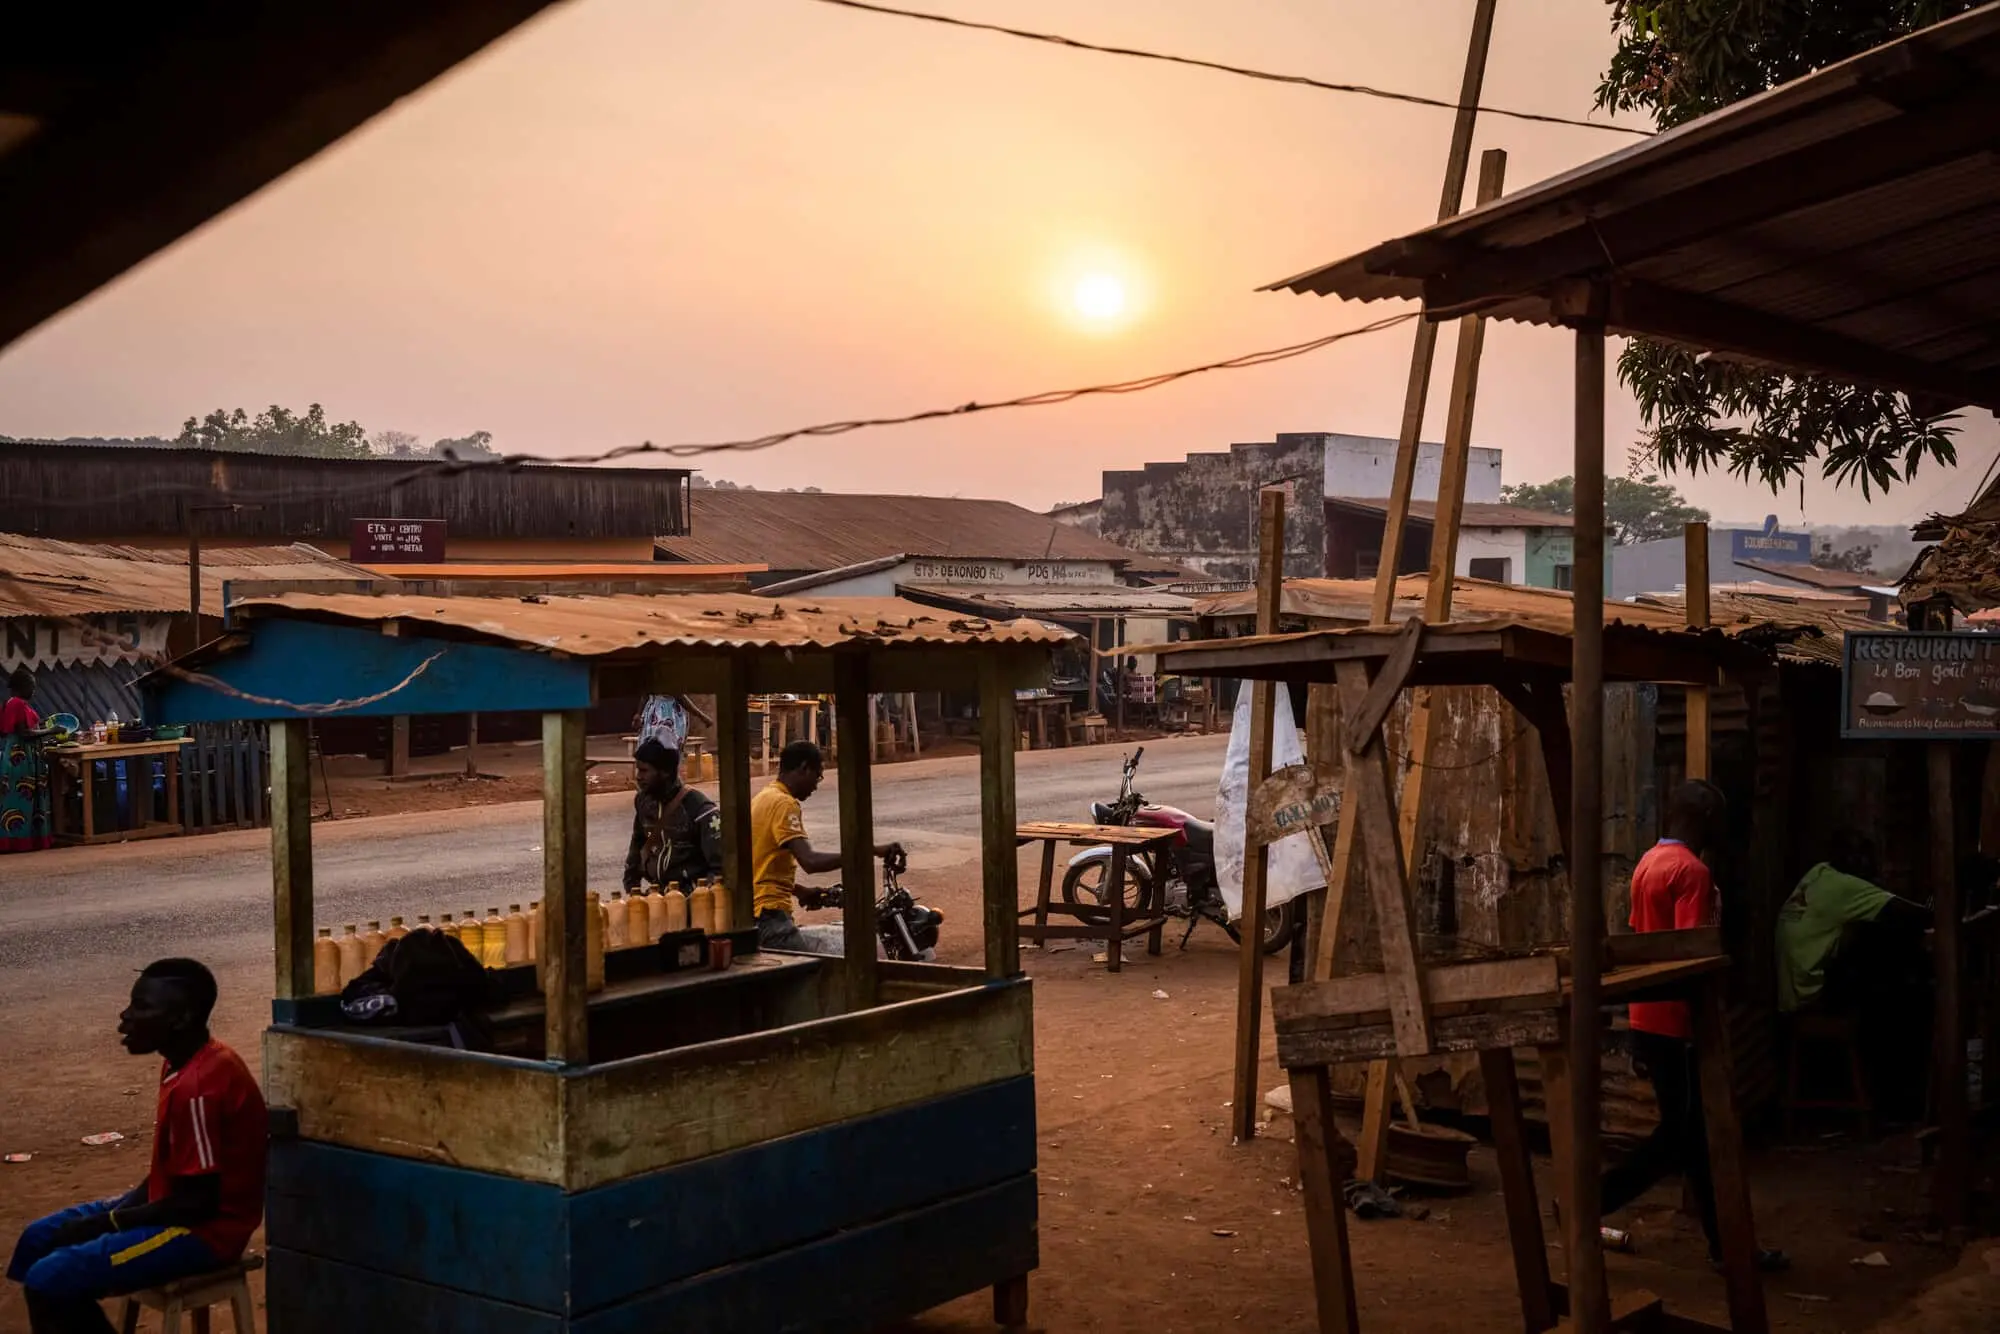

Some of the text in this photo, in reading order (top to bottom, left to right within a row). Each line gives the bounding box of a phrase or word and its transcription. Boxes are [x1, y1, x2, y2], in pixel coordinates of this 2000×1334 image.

[367, 523, 386, 534] ETS
[405, 534, 421, 543] JUS
[1027, 565, 1049, 580] PDG
[1894, 662, 1921, 679] Bon
